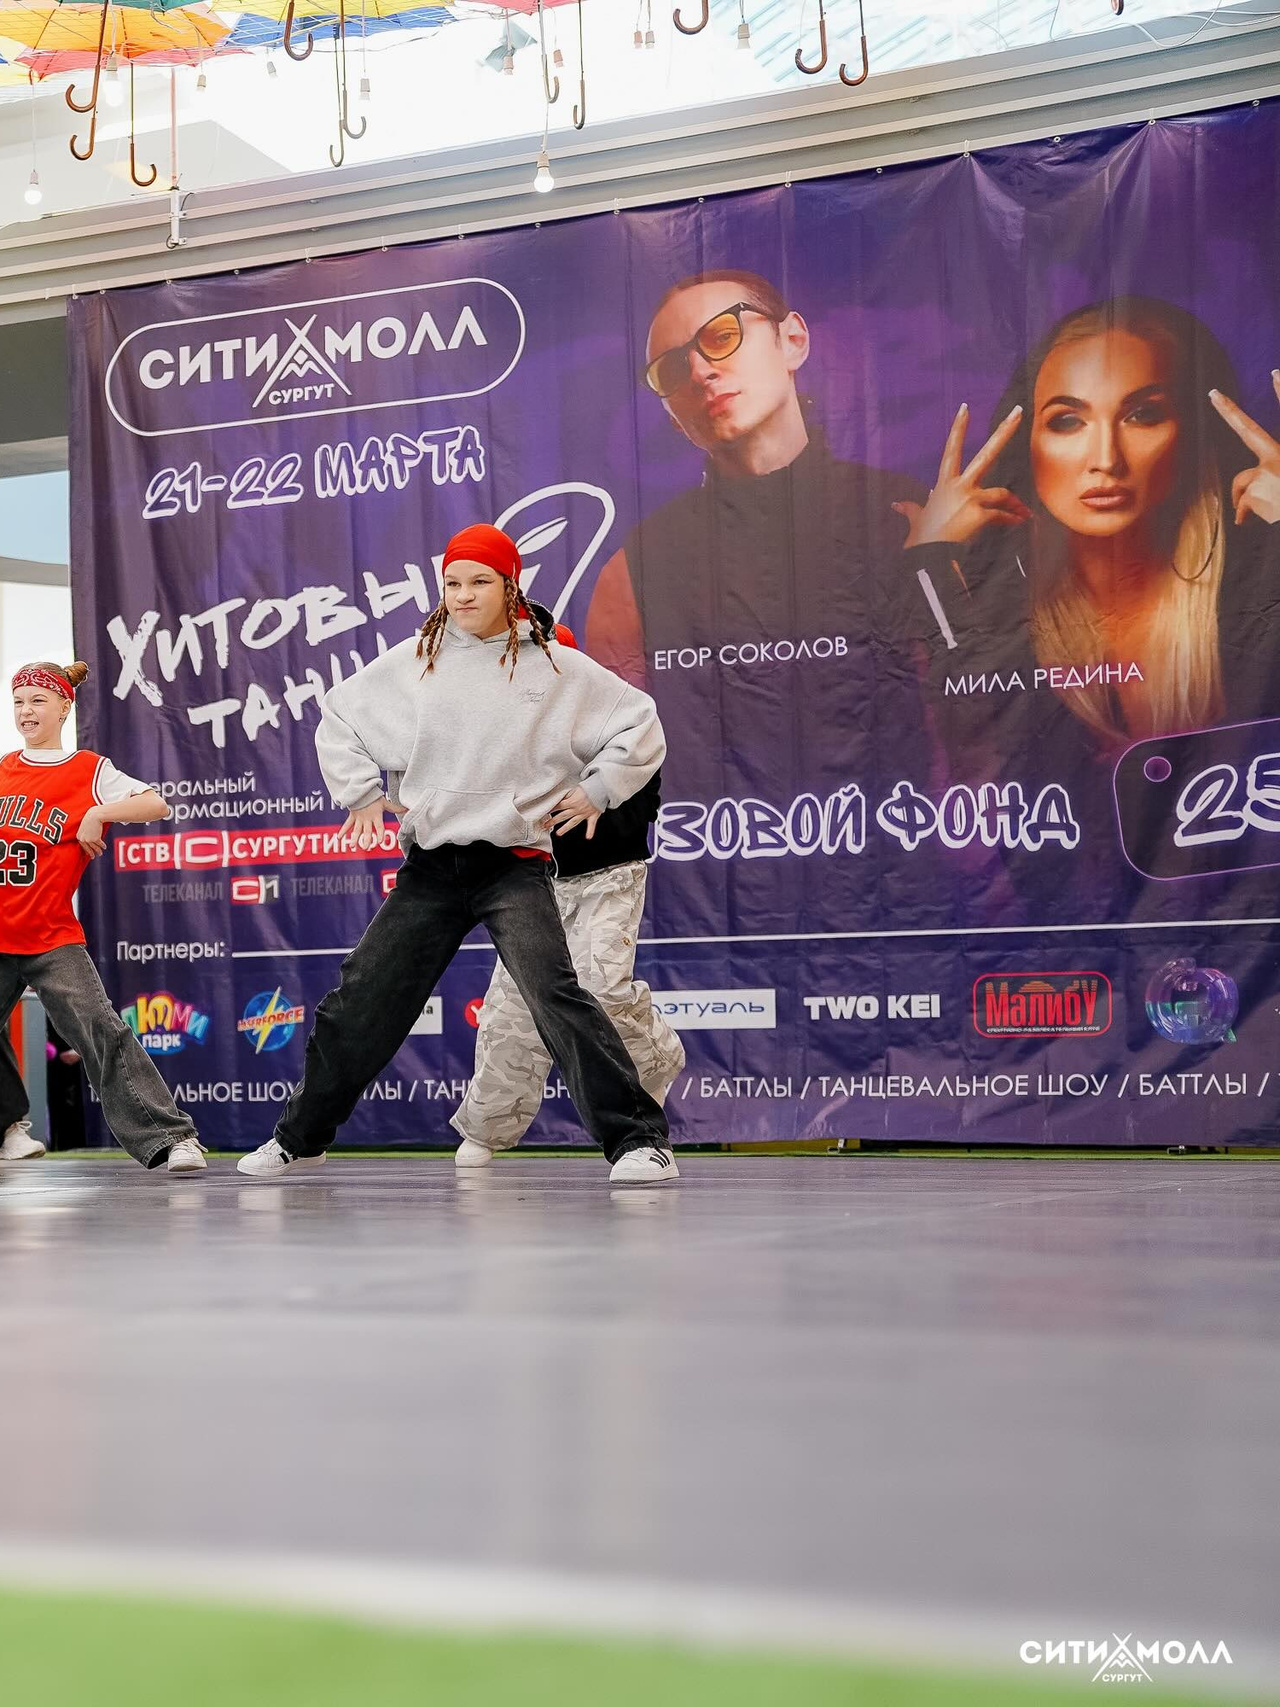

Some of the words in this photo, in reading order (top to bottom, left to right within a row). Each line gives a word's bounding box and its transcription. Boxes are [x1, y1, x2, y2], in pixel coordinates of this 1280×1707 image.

[139, 333, 277, 390] СИТИ
[325, 306, 488, 363] МОЛЛ
[269, 382, 335, 405] СУРГУТ
[142, 452, 304, 520] 21-22
[314, 425, 487, 499] МАРТА
[106, 553, 445, 707] ХИТОВЫ
[654, 647, 712, 671] ЕГОР
[719, 636, 849, 665] СОКОЛОВ
[944, 666, 1025, 697] МИЛА
[1035, 661, 1144, 690] РЕДИНА
[148, 771, 256, 800] еральный
[162, 790, 323, 825] ормационный
[647, 783, 866, 863] ЗОВОЙ
[876, 780, 1081, 854] ФОНД
[142, 881, 224, 903] ТЕЛЕКАНАЛ
[290, 874, 374, 897] ТЕЛЕКАНАЛ
[117, 940, 225, 964] Партнеры:
[803, 996, 883, 1020] TWO
[887, 994, 941, 1018] KEI
[142, 1034, 181, 1051] парк
[248, 1081, 300, 1102] ШОУ
[700, 1076, 792, 1099] БАТТЛЫ
[818, 1074, 1028, 1099] ТАНЦЕВАЛЬНОЕ
[1038, 1073, 1108, 1098] ШОУ
[1138, 1072, 1247, 1096] БАТТЛЫ
